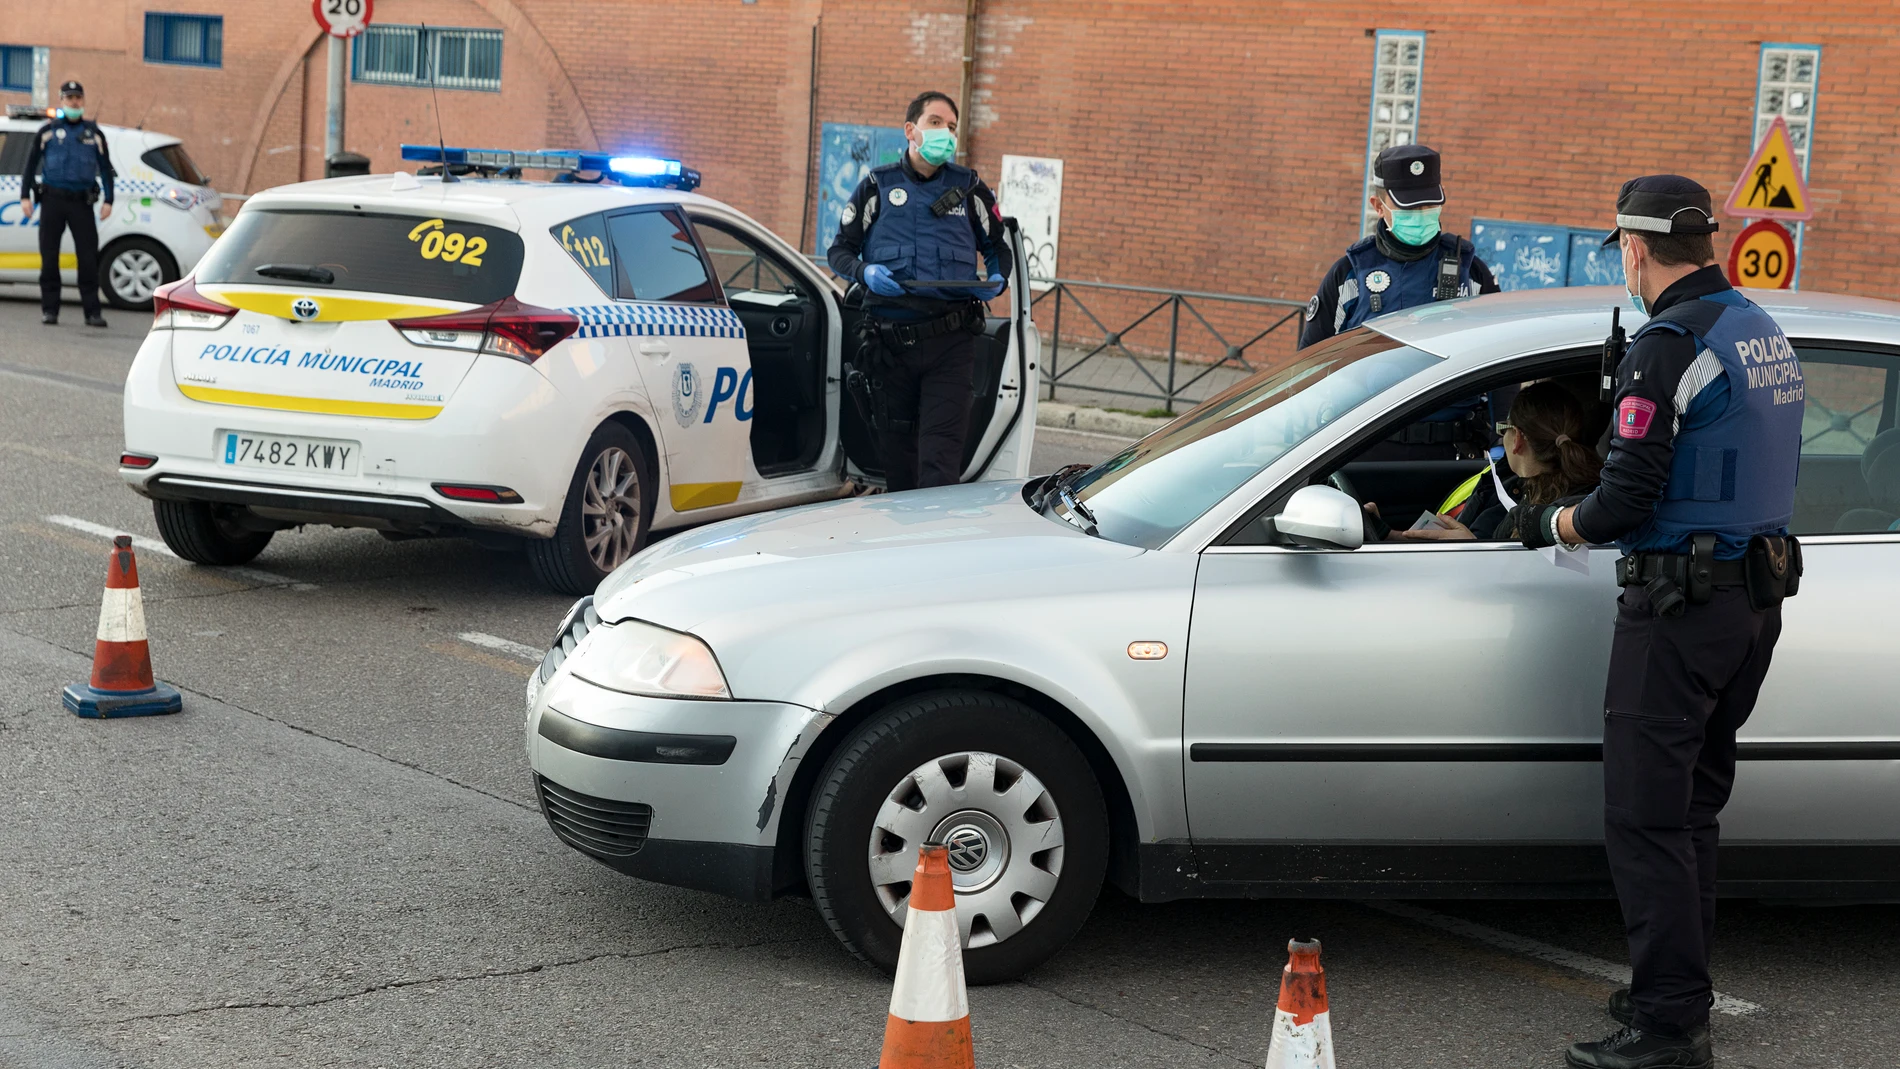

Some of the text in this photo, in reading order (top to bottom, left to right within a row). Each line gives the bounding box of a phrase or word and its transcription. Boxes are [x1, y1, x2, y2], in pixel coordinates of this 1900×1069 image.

[328, 0, 361, 15] 20
[945, 204, 966, 216] LICÍA
[421, 231, 488, 267] 092
[573, 235, 611, 268] 112
[1743, 249, 1783, 278] 30
[242, 323, 260, 335] 7067
[1734, 326, 1796, 366] POLICÍA
[199, 343, 424, 379] POLICÍA MUNICIPAL
[1746, 360, 1803, 390] MUNICIPAL
[369, 378, 424, 391] MADRID
[1773, 383, 1804, 406] Madrid
[240, 438, 351, 471] 7482 KWY
